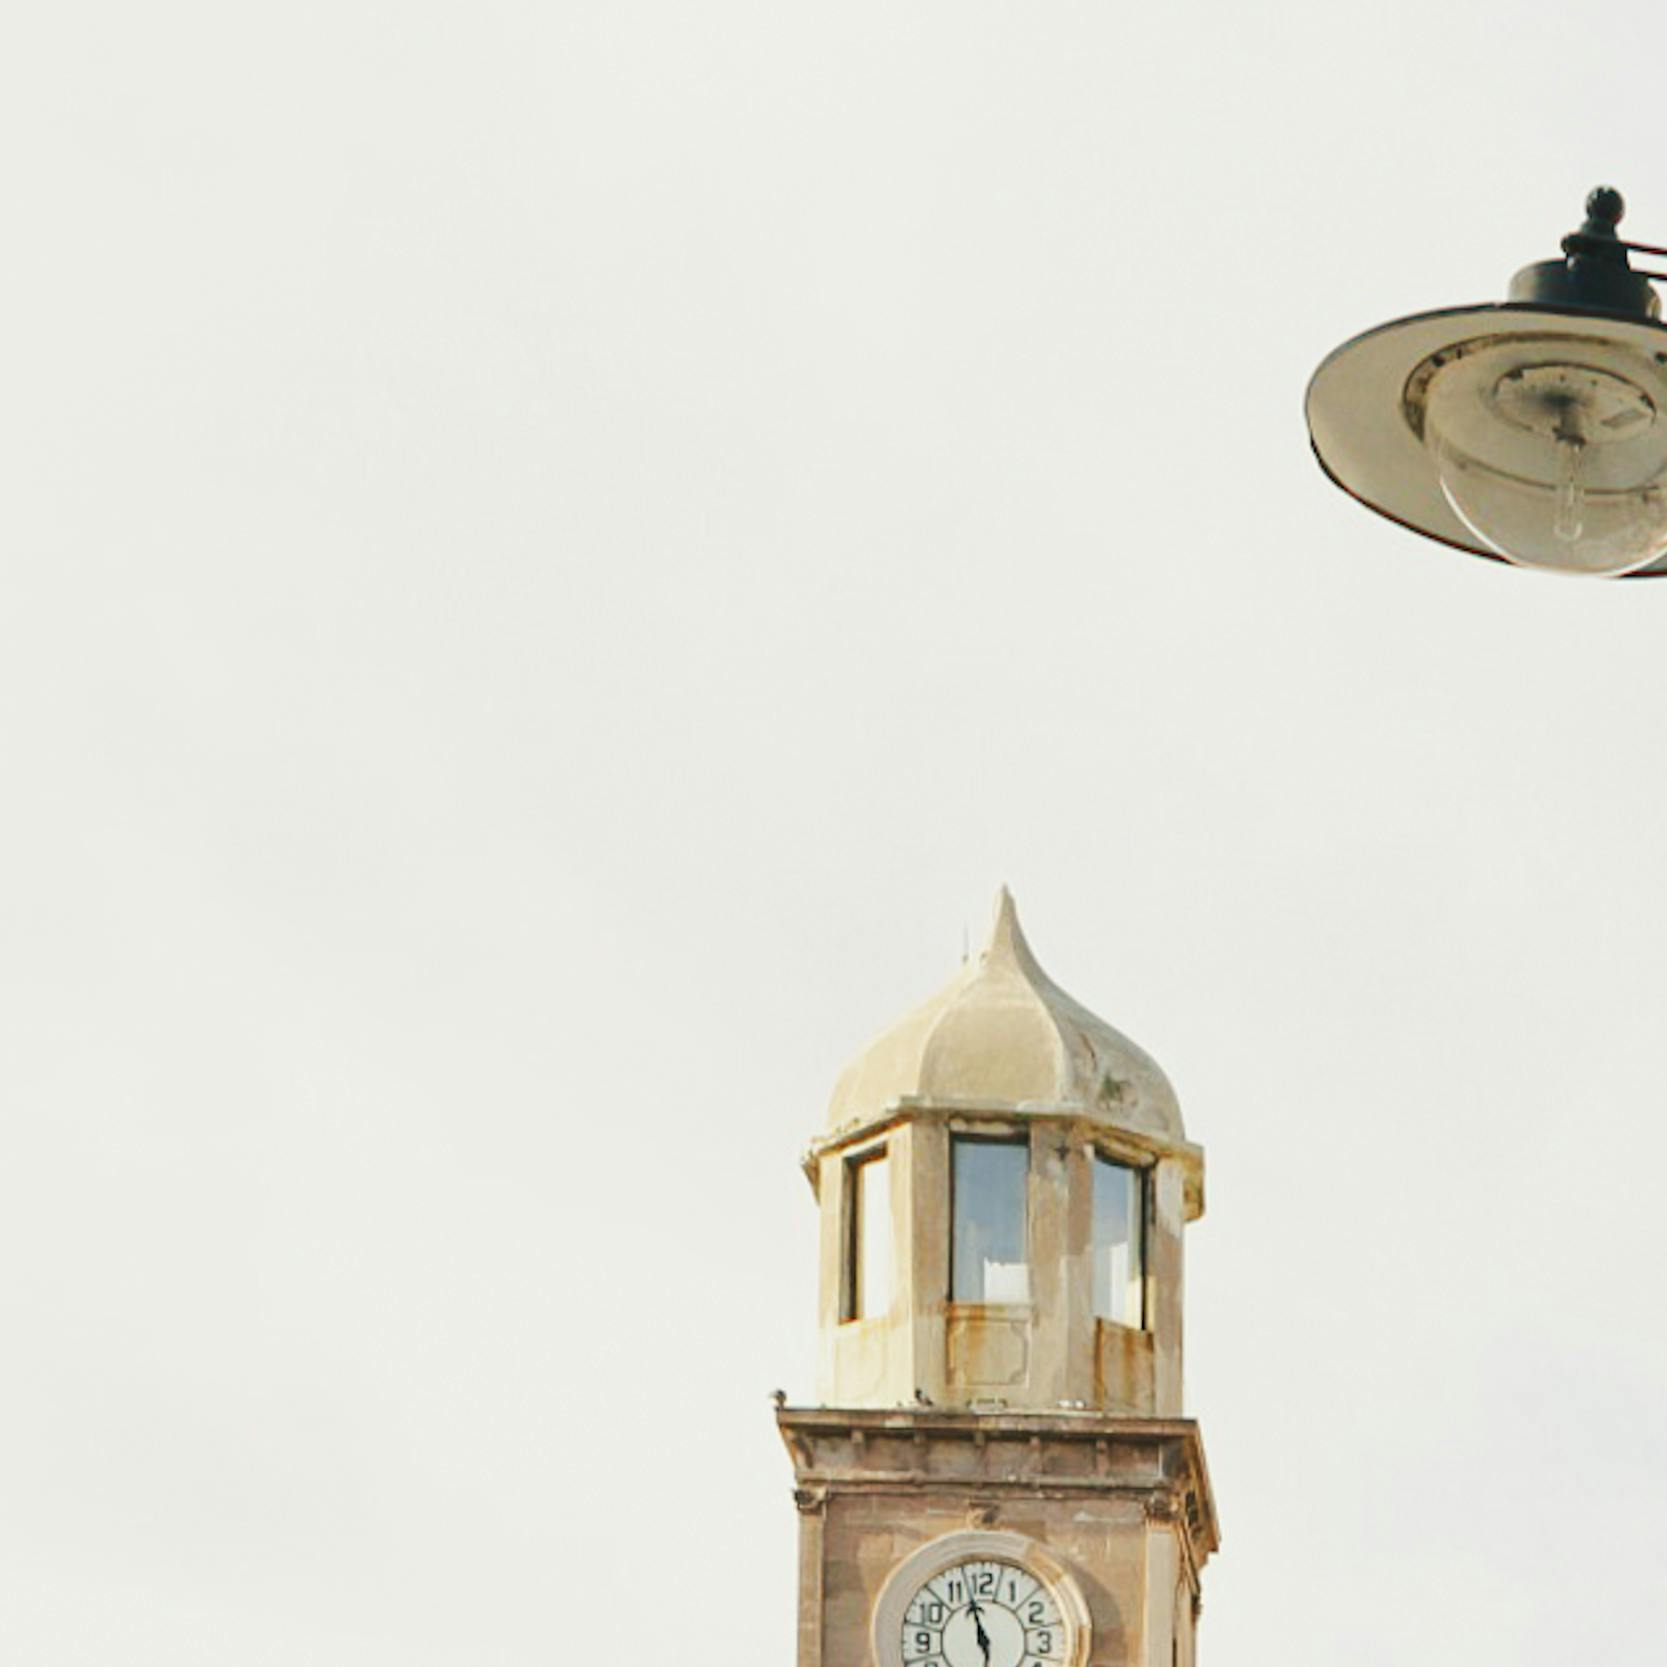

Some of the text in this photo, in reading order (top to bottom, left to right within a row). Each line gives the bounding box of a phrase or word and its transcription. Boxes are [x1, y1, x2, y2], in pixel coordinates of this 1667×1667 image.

[948, 1581, 963, 1602] 11
[971, 1572, 994, 1595] 12
[919, 1603, 943, 1624] 10
[1028, 1601, 1045, 1624] 2
[915, 1632, 931, 1653] 9
[1037, 1632, 1051, 1654] 3
